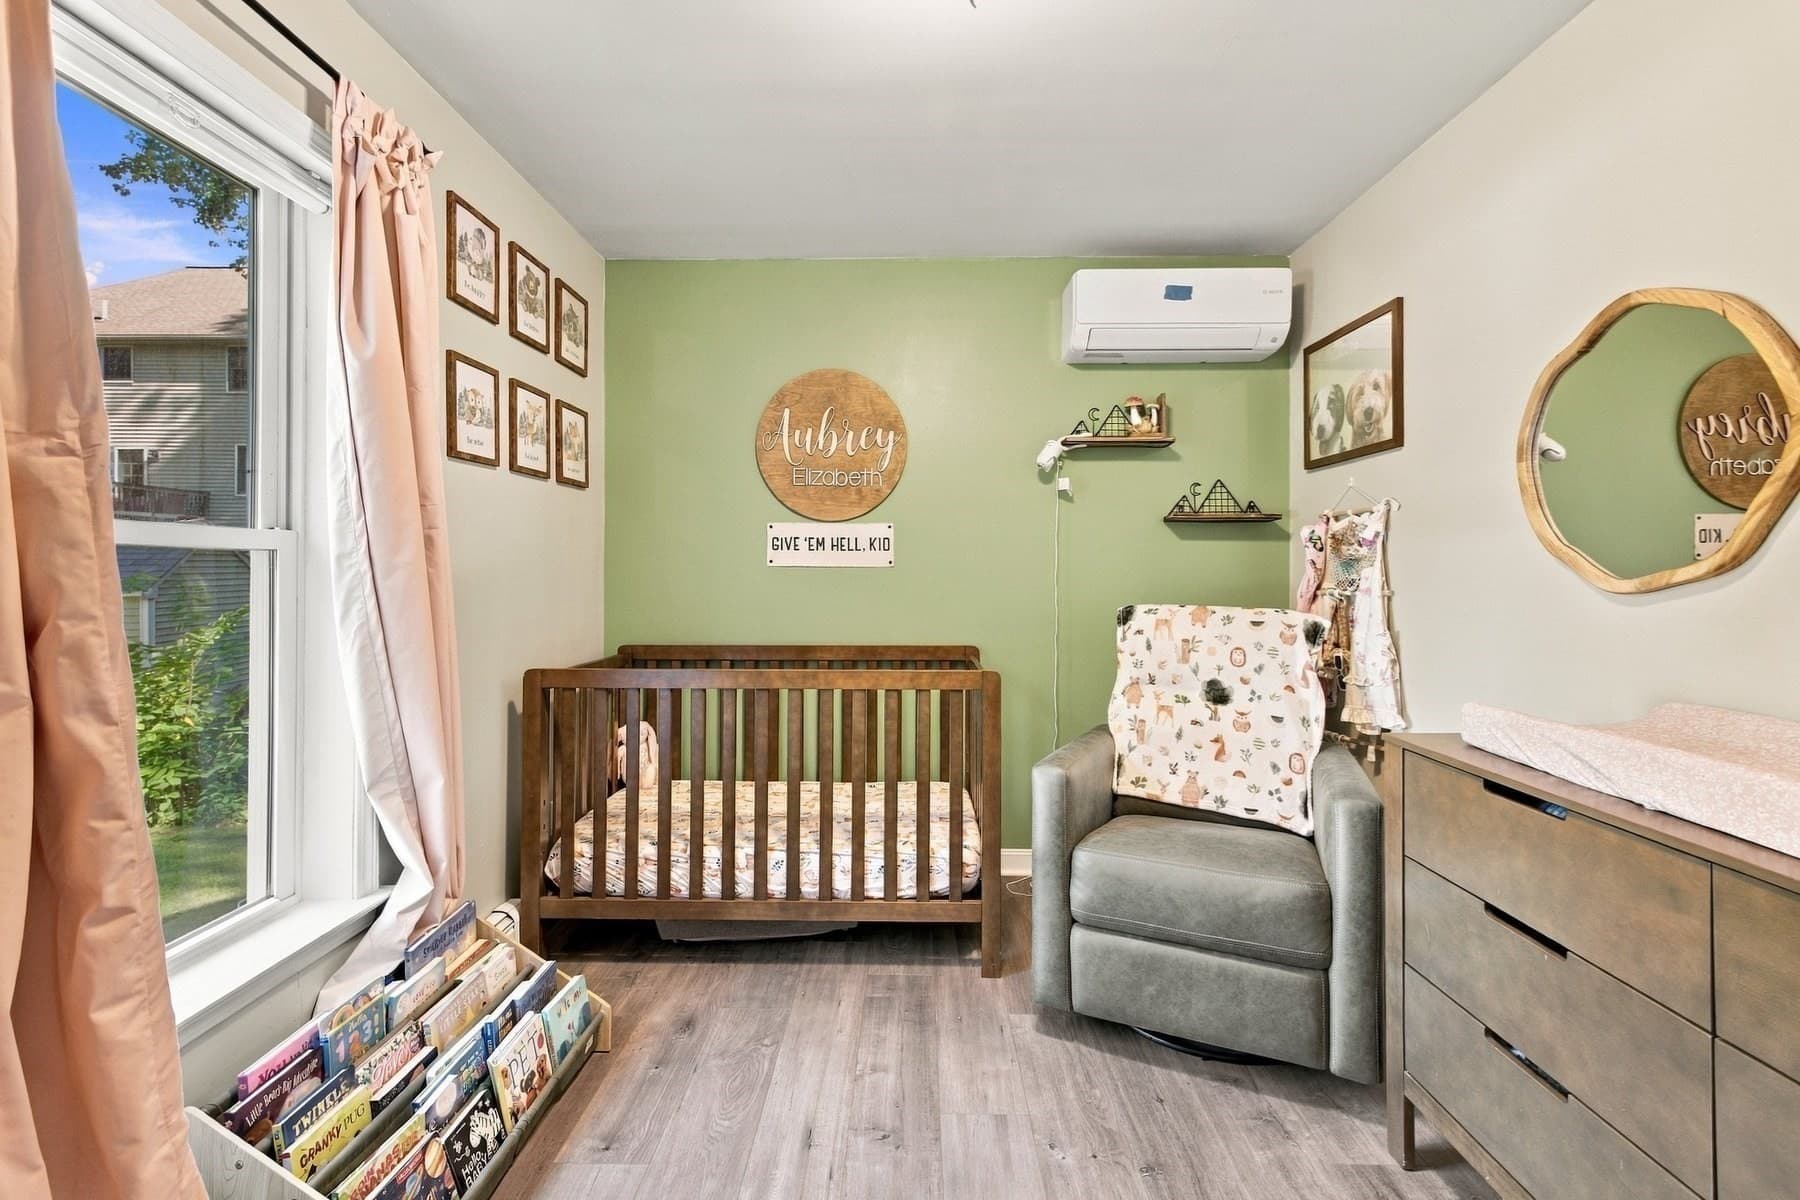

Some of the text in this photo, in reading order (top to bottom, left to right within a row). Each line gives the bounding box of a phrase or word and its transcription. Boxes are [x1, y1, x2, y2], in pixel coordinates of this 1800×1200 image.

[762, 406, 903, 472] Aubrey
[792, 467, 884, 487] Elizabeth
[771, 536, 800, 552] GIVE
[831, 537, 866, 553] HELL,
[869, 536, 891, 552] KID
[245, 1102, 264, 1127] Little
[292, 1080, 350, 1137] TWINKLE
[341, 1102, 365, 1130] PUG
